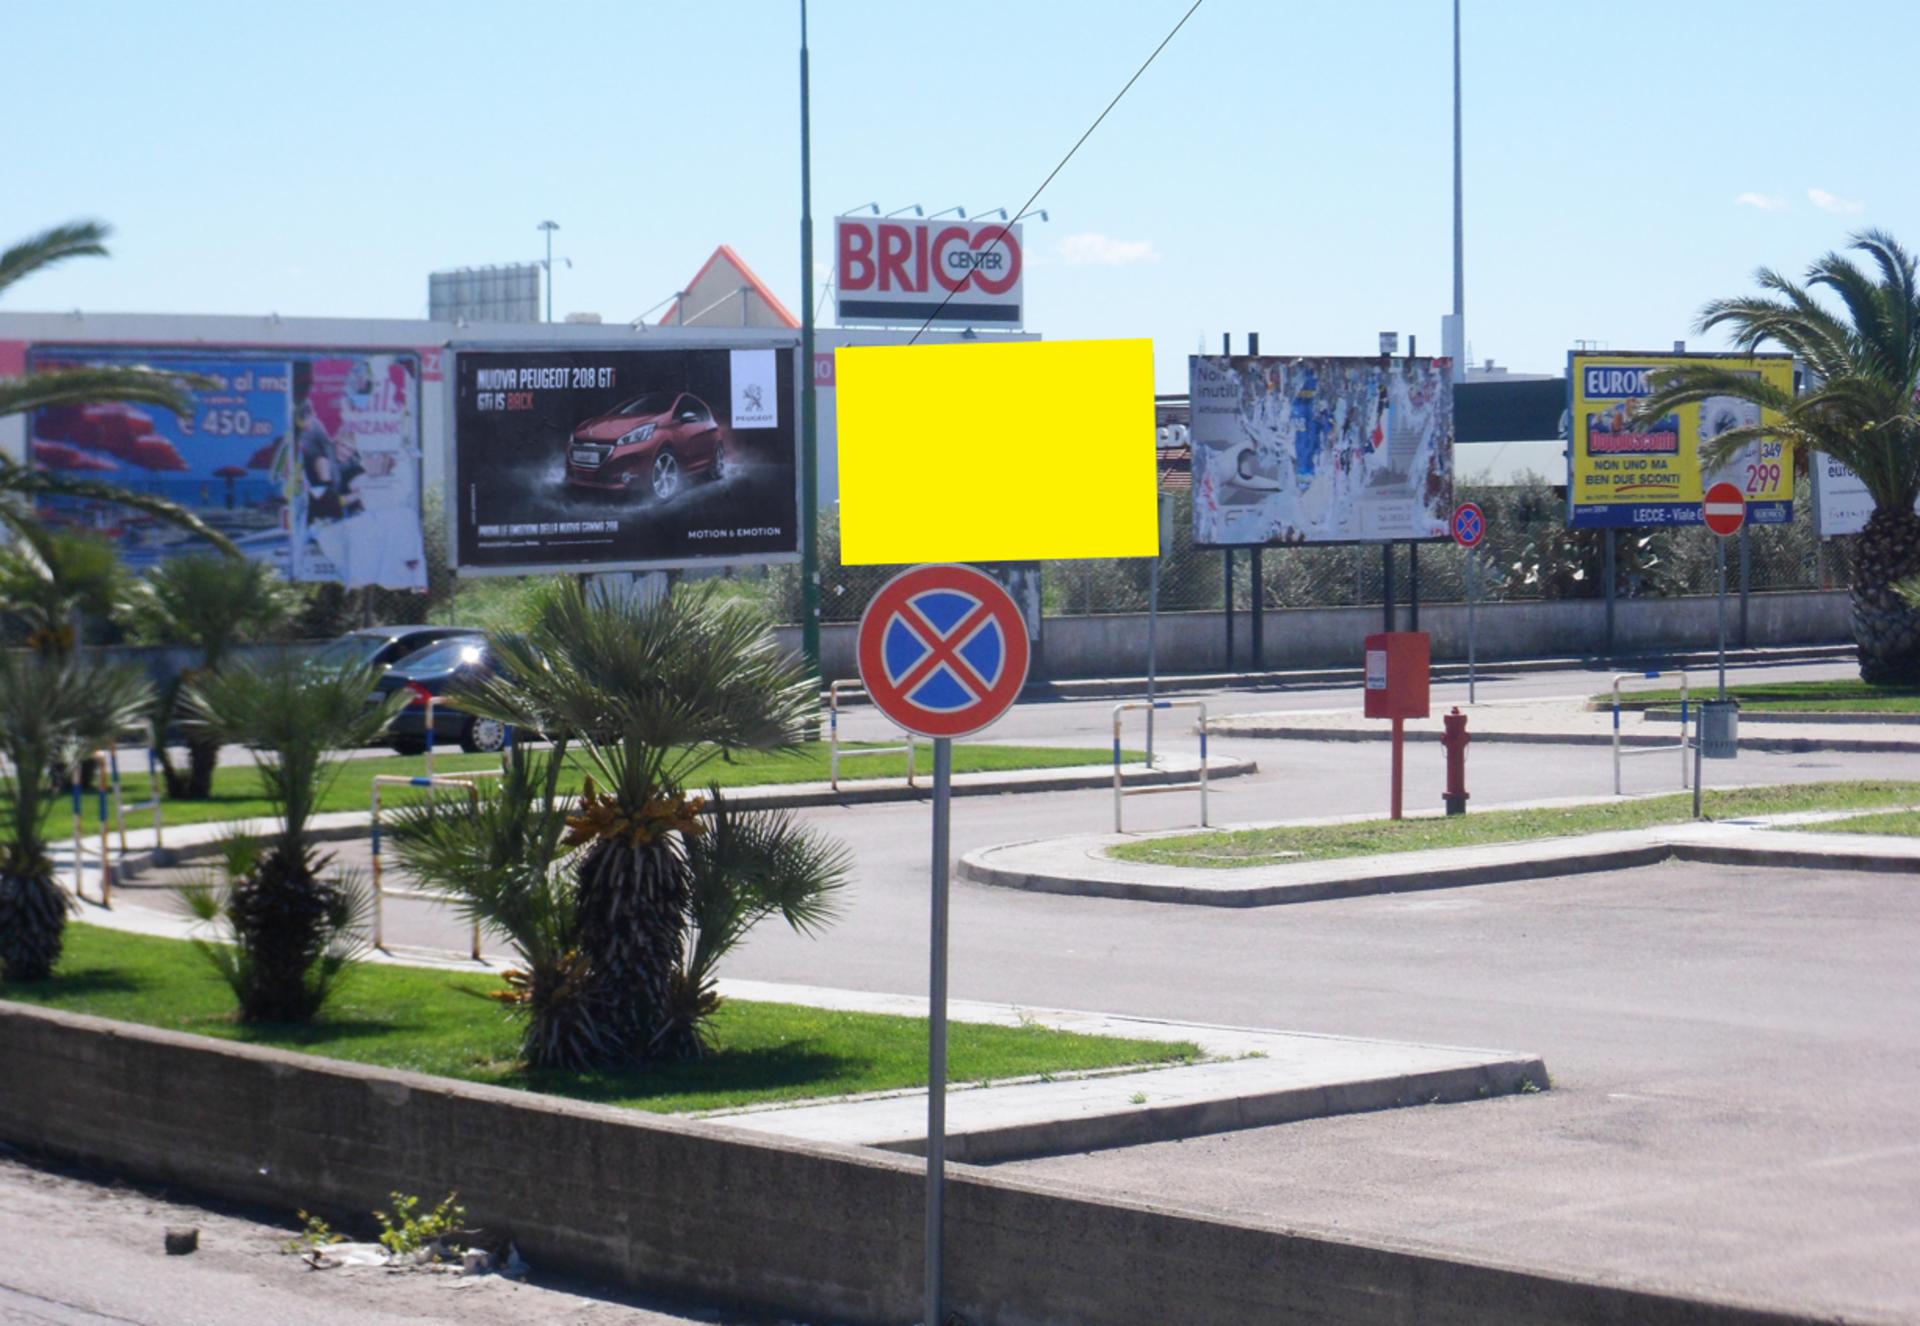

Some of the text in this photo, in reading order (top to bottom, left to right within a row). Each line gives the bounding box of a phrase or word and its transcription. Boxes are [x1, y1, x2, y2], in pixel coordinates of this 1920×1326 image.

[839, 223, 1022, 295] BRICO
[948, 251, 1003, 270] CENTER
[477, 368, 517, 390] NUOVA
[519, 368, 570, 389] PEUGEOT
[572, 367, 596, 388] 208
[507, 391, 534, 411] BACK
[1594, 459, 1669, 471] NON UNO MA
[1585, 473, 1680, 485] BEN DUE SCONTI
[1746, 464, 1781, 493] 299
[1633, 508, 1665, 522] LECCE
[1673, 508, 1696, 521] Viale
[688, 529, 727, 539] MOTION
[737, 527, 781, 537] EMOTION
